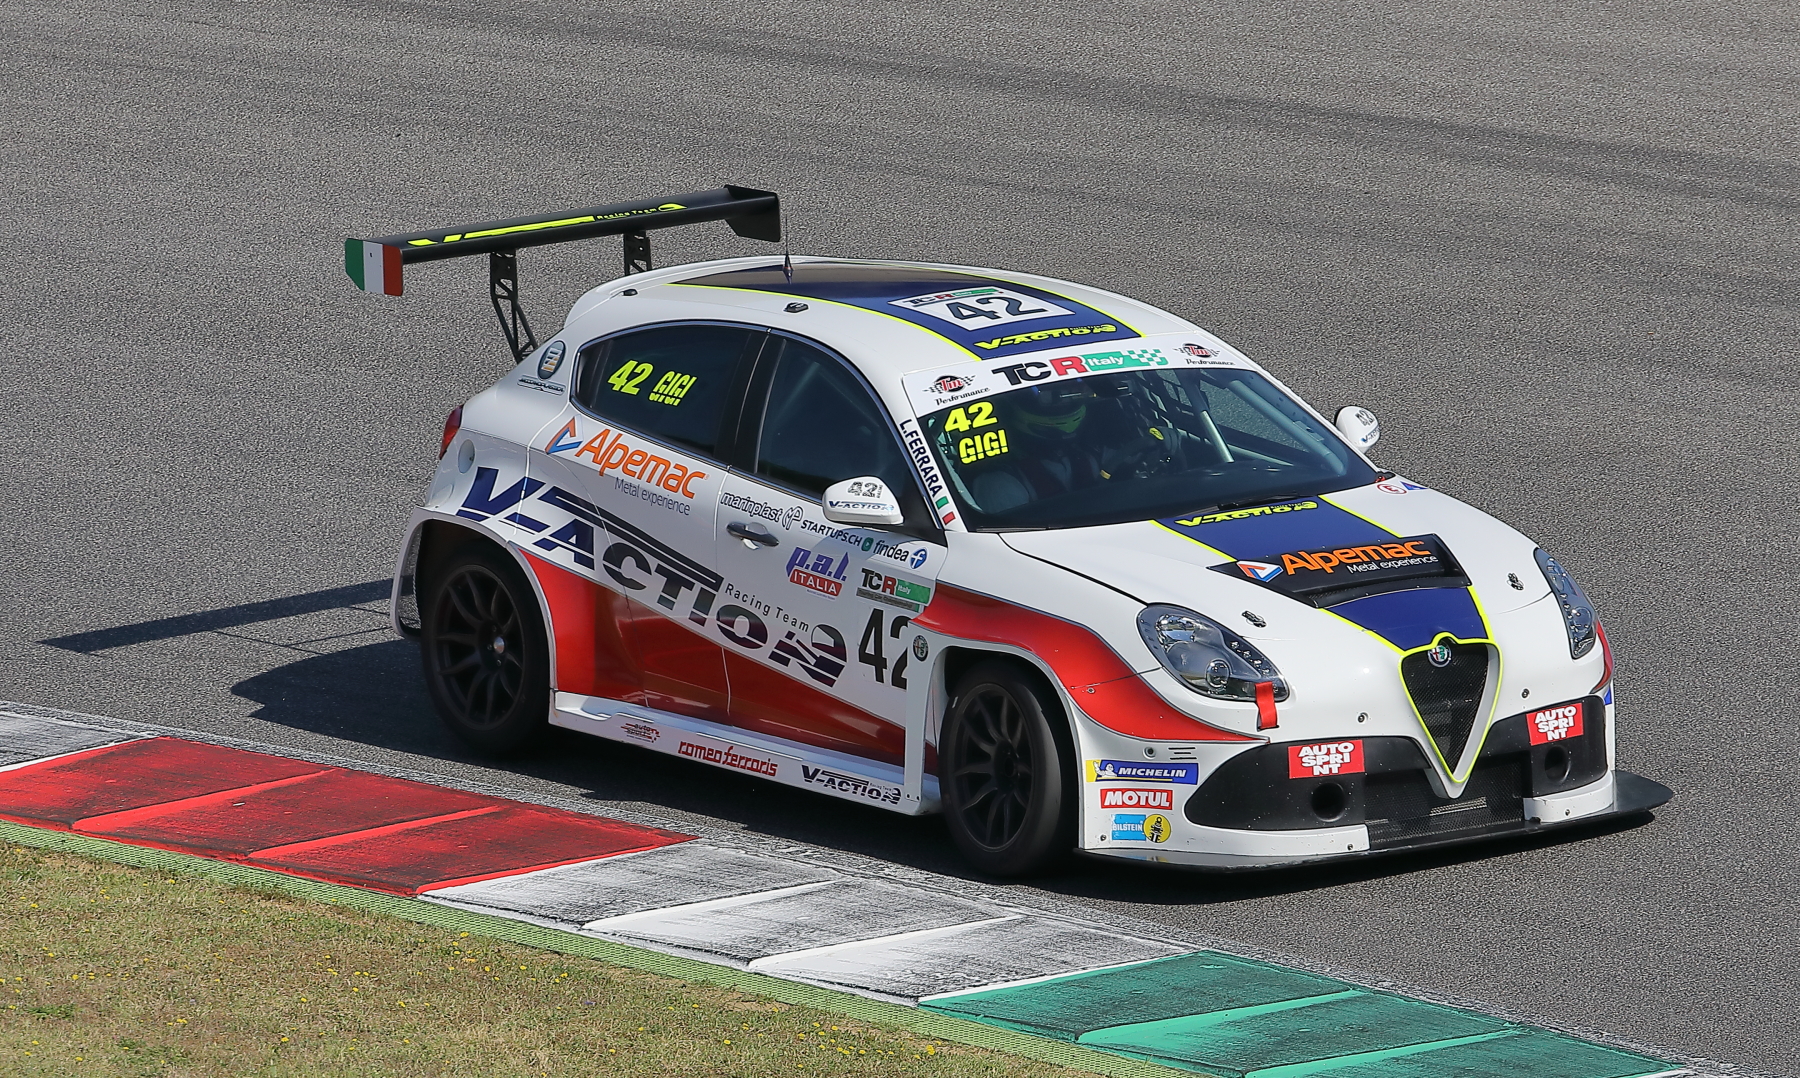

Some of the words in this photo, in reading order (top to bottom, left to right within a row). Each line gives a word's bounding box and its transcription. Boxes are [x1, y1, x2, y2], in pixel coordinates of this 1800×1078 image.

[945, 296, 1049, 321] 42
[991, 356, 1088, 386] TCR
[1086, 354, 1125, 368] Italy
[607, 359, 654, 396] 42
[648, 371, 698, 406] GIGI
[944, 401, 998, 432] 42
[574, 428, 706, 499] Alpemac
[899, 418, 943, 498] L.FERRARA
[614, 477, 640, 499] Metal
[641, 487, 691, 516] experience
[847, 481, 878, 498] 42
[720, 492, 783, 523] marinplast
[801, 519, 863, 547] STARTUPS.CH
[873, 540, 910, 562] findea
[1281, 541, 1431, 576] Alpemac
[1346, 561, 1380, 574] Metal
[1379, 555, 1438, 570] experience
[454, 466, 848, 688] V-ACTION
[794, 571, 837, 595] ITALIA
[861, 567, 897, 596] TCR
[725, 583, 771, 616] Racing
[776, 606, 810, 633] Team
[1534, 706, 1577, 724] AUTO
[1537, 717, 1575, 733] SPRI
[1546, 728, 1568, 742] NT
[678, 741, 722, 763] romeo
[1298, 742, 1355, 757] AUTO
[1301, 752, 1350, 767] SPRI
[1118, 767, 1187, 778] MICHELIN
[1312, 763, 1341, 776] NT
[801, 764, 902, 805] V-ACTION
[1104, 790, 1170, 807] MOTUL
[1112, 822, 1143, 832] BILSTEIN
